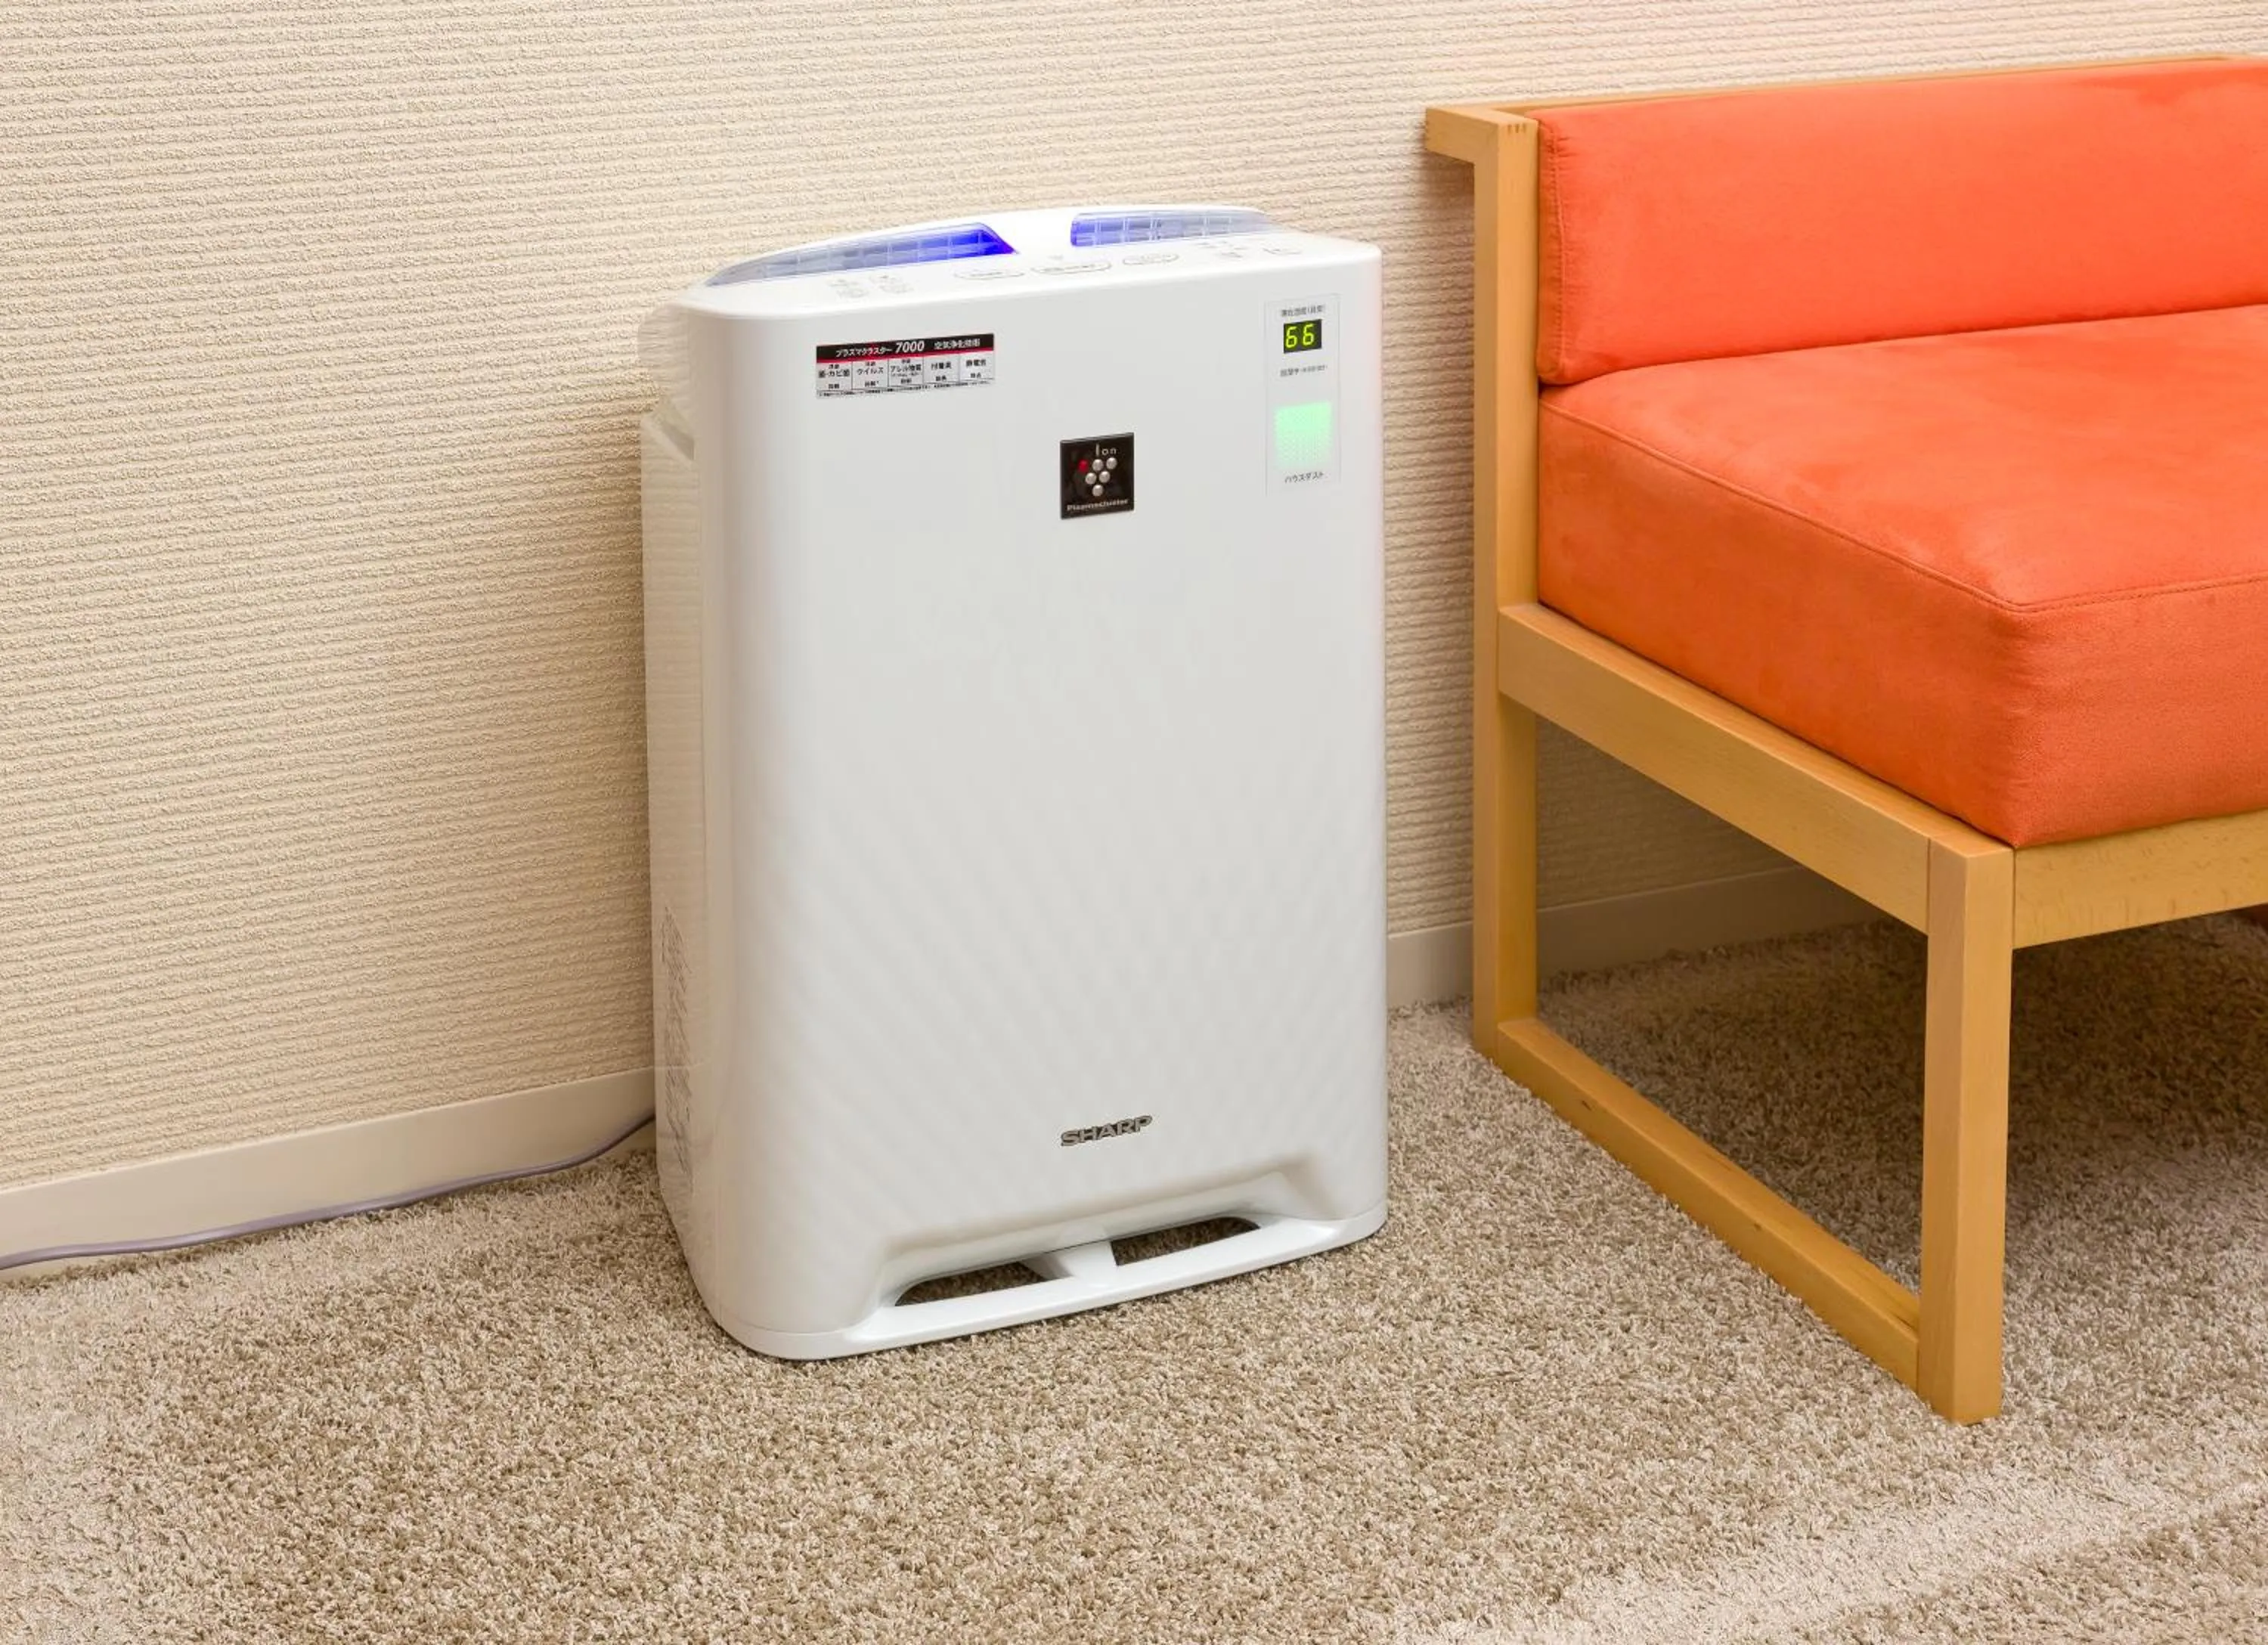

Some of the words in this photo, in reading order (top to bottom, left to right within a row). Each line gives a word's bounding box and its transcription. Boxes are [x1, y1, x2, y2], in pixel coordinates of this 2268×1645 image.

[1285, 323, 1315, 349] 66
[835, 347, 892, 358] プラズマクラスター
[895, 340, 925, 353] 7000
[857, 366, 884, 376] ウイルス
[1095, 443, 1117, 457] Ion
[1061, 1115, 1153, 1146] SHARP
